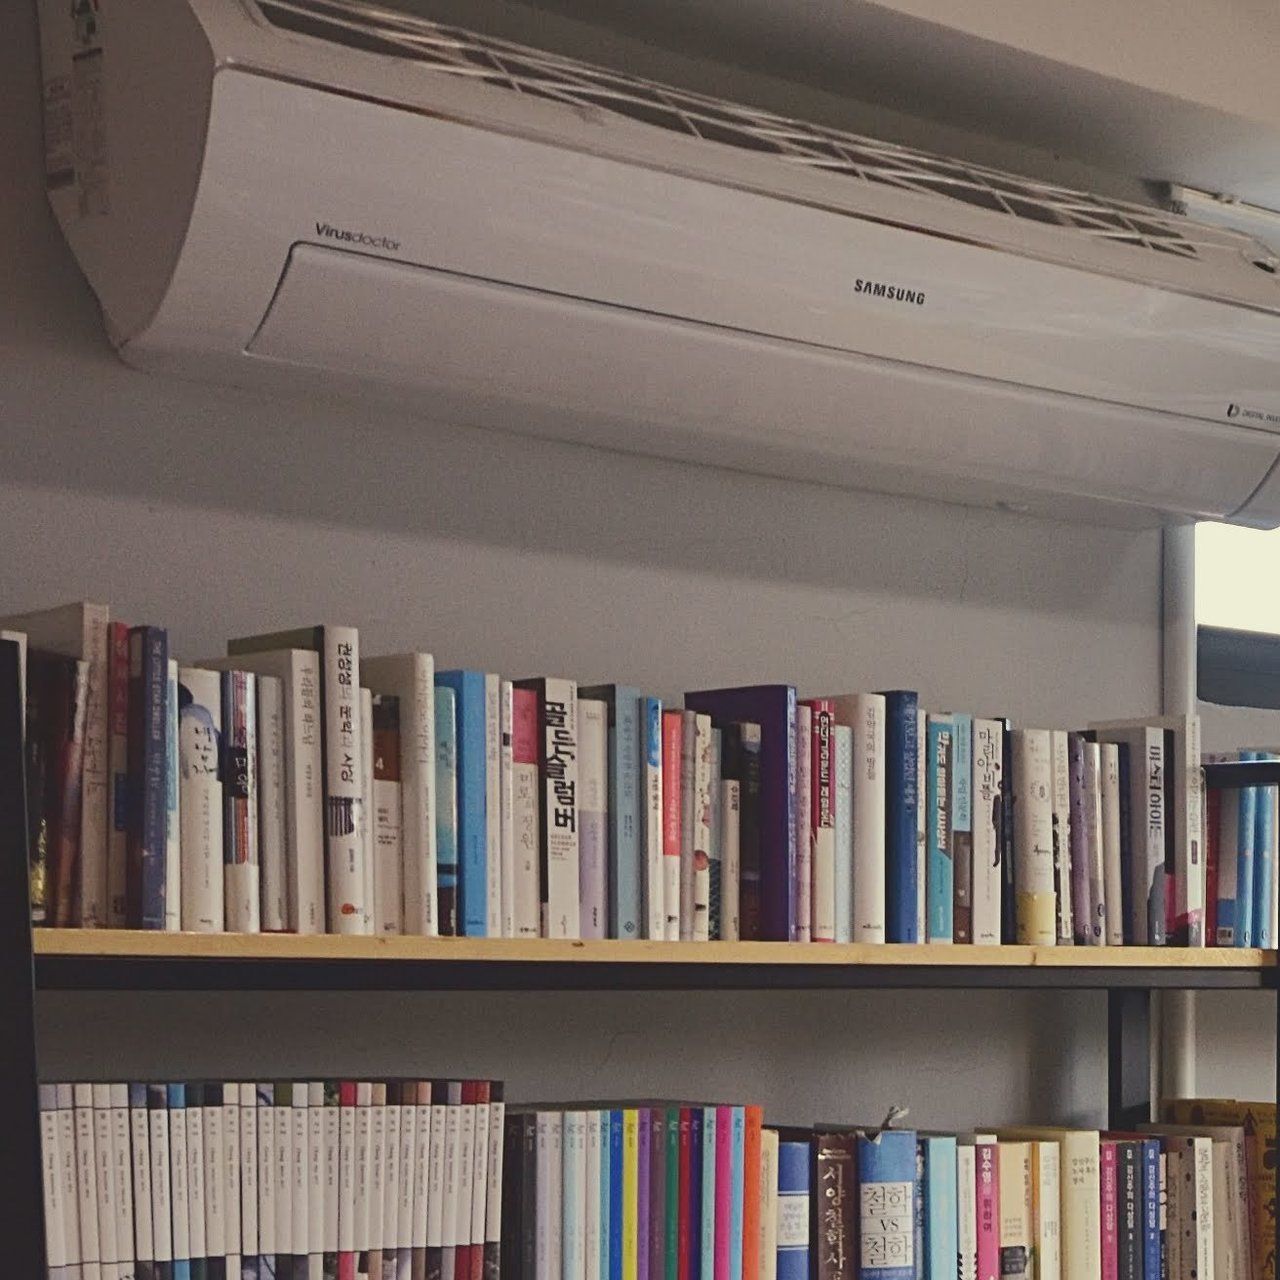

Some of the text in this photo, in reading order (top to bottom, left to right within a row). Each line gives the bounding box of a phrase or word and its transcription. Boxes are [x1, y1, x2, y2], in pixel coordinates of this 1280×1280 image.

[854, 279, 925, 305] SAMSUNG
[300, 713, 315, 746] 하느님
[338, 642, 356, 784] 권정생의 문학과 사상
[375, 757, 384, 770] 4
[1149, 746, 1162, 790] 미스터
[823, 1164, 845, 1269] 서양철학사
[864, 1185, 910, 1266] 철학 VS 철학
